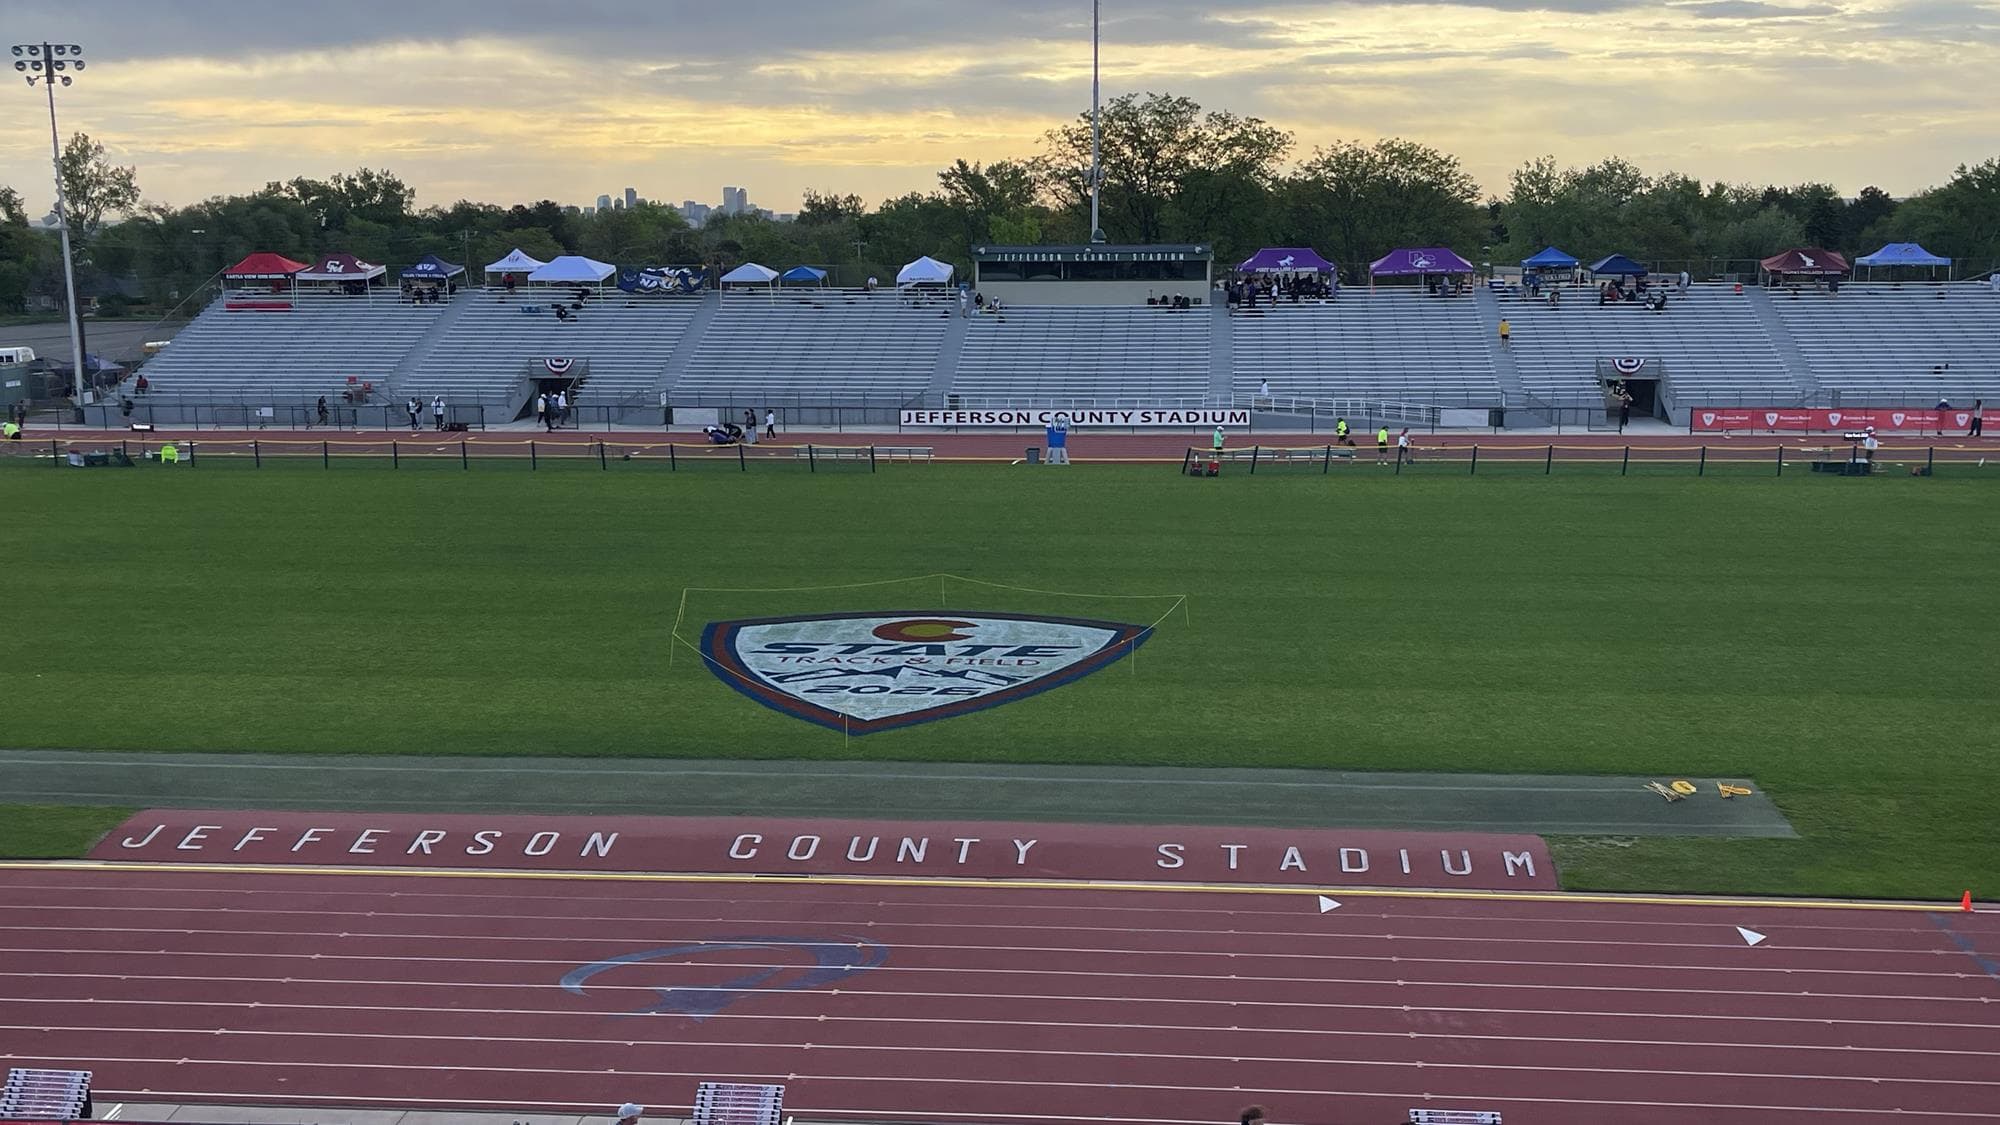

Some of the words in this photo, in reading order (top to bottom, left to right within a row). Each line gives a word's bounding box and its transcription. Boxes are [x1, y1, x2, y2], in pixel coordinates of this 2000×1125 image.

[997, 253, 1062, 262] JEFFERSON
[1074, 253, 1119, 262] COUNTY
[1132, 253, 1184, 262] STADIUM
[903, 411, 1031, 424] JEFFERSON
[1140, 411, 1248, 424] STADIUM
[747, 642, 1082, 657] STATE
[777, 656, 892, 665] TRACK
[905, 657, 933, 666] &
[946, 658, 1041, 667] FIELD
[802, 684, 986, 697] 2026
[122, 823, 619, 858] JEFFERSON
[728, 833, 1038, 867] COUNTY
[1157, 842, 1538, 879] STADIUM
